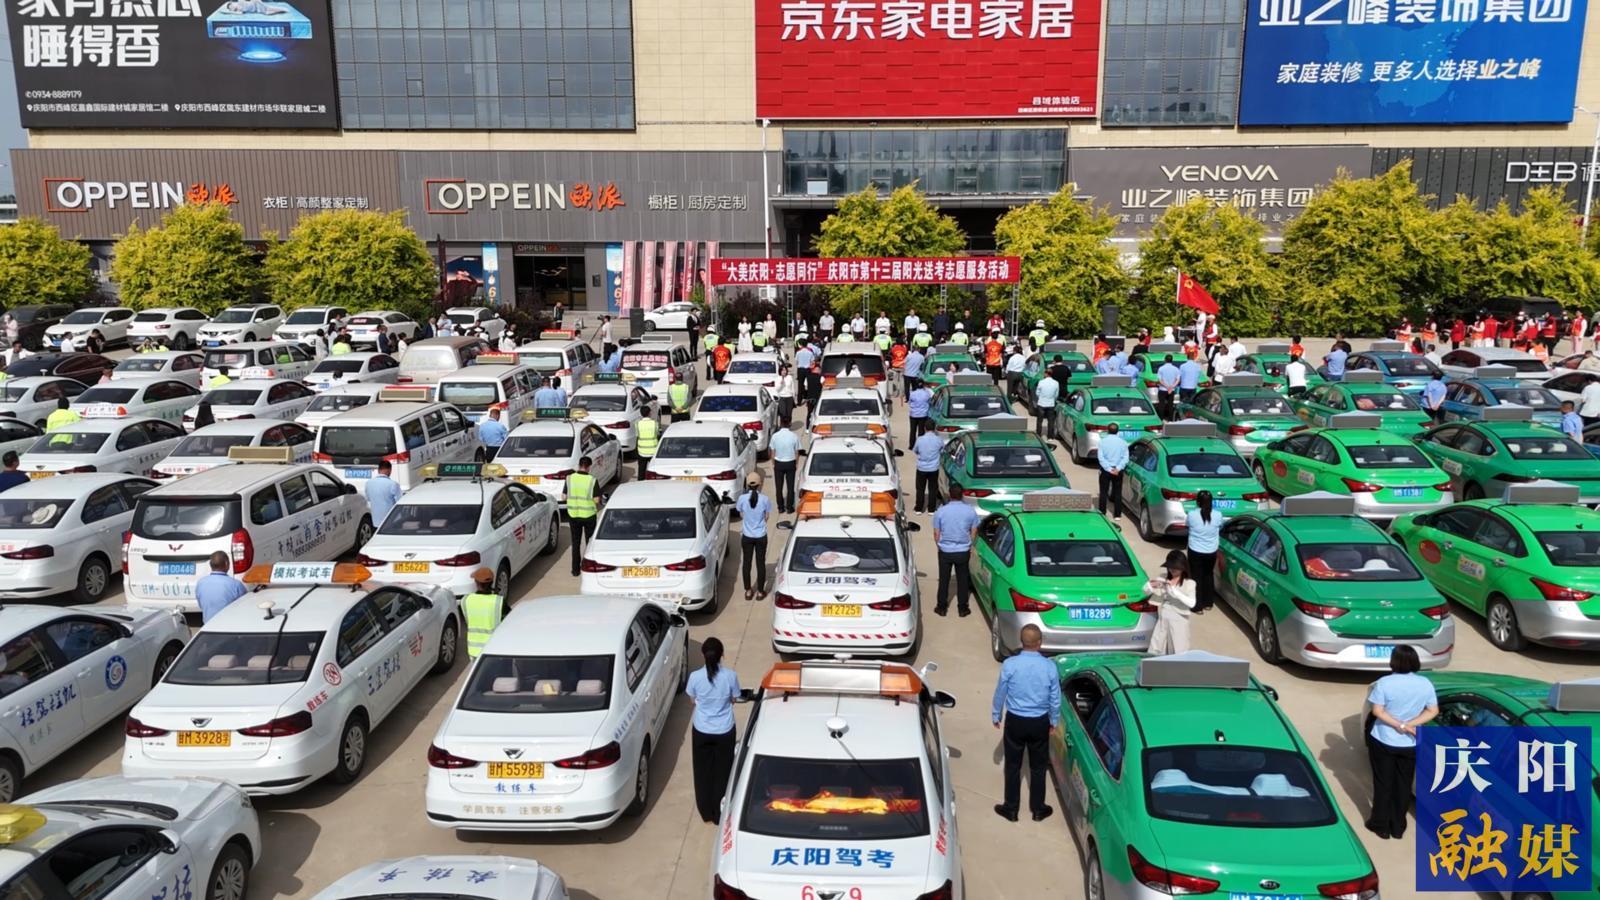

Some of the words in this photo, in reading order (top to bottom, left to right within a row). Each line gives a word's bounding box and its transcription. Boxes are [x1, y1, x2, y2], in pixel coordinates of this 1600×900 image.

[781, 0, 1074, 40] 京东家电家居
[1259, 0, 1572, 26] 业之峰装饰集团
[23, 25, 160, 67] 睡得香
[1277, 62, 1363, 84] 家庭装修
[1371, 58, 1542, 82] 更多人选择业之峰
[1160, 165, 1279, 182] YENOVA
[57, 181, 184, 209] OPPEIN
[187, 183, 239, 205] 欧派
[263, 196, 288, 209] 衣柜
[296, 197, 368, 209] 高颜整家定制
[438, 183, 566, 210] OPPEIN
[569, 183, 626, 211] 欧派
[648, 194, 678, 209] 橱柜
[687, 195, 747, 209] 厨房定制
[828, 261, 1009, 280] 庆阳市第十三届阳光送考志愿服务活动
[273, 566, 331, 579] 模拟考试车
[806, 576, 877, 585] 庆阳驾考
[494, 781, 537, 793] 教练车
[519, 804, 565, 815] 注意安全
[771, 847, 895, 869] 庆阳驾考
